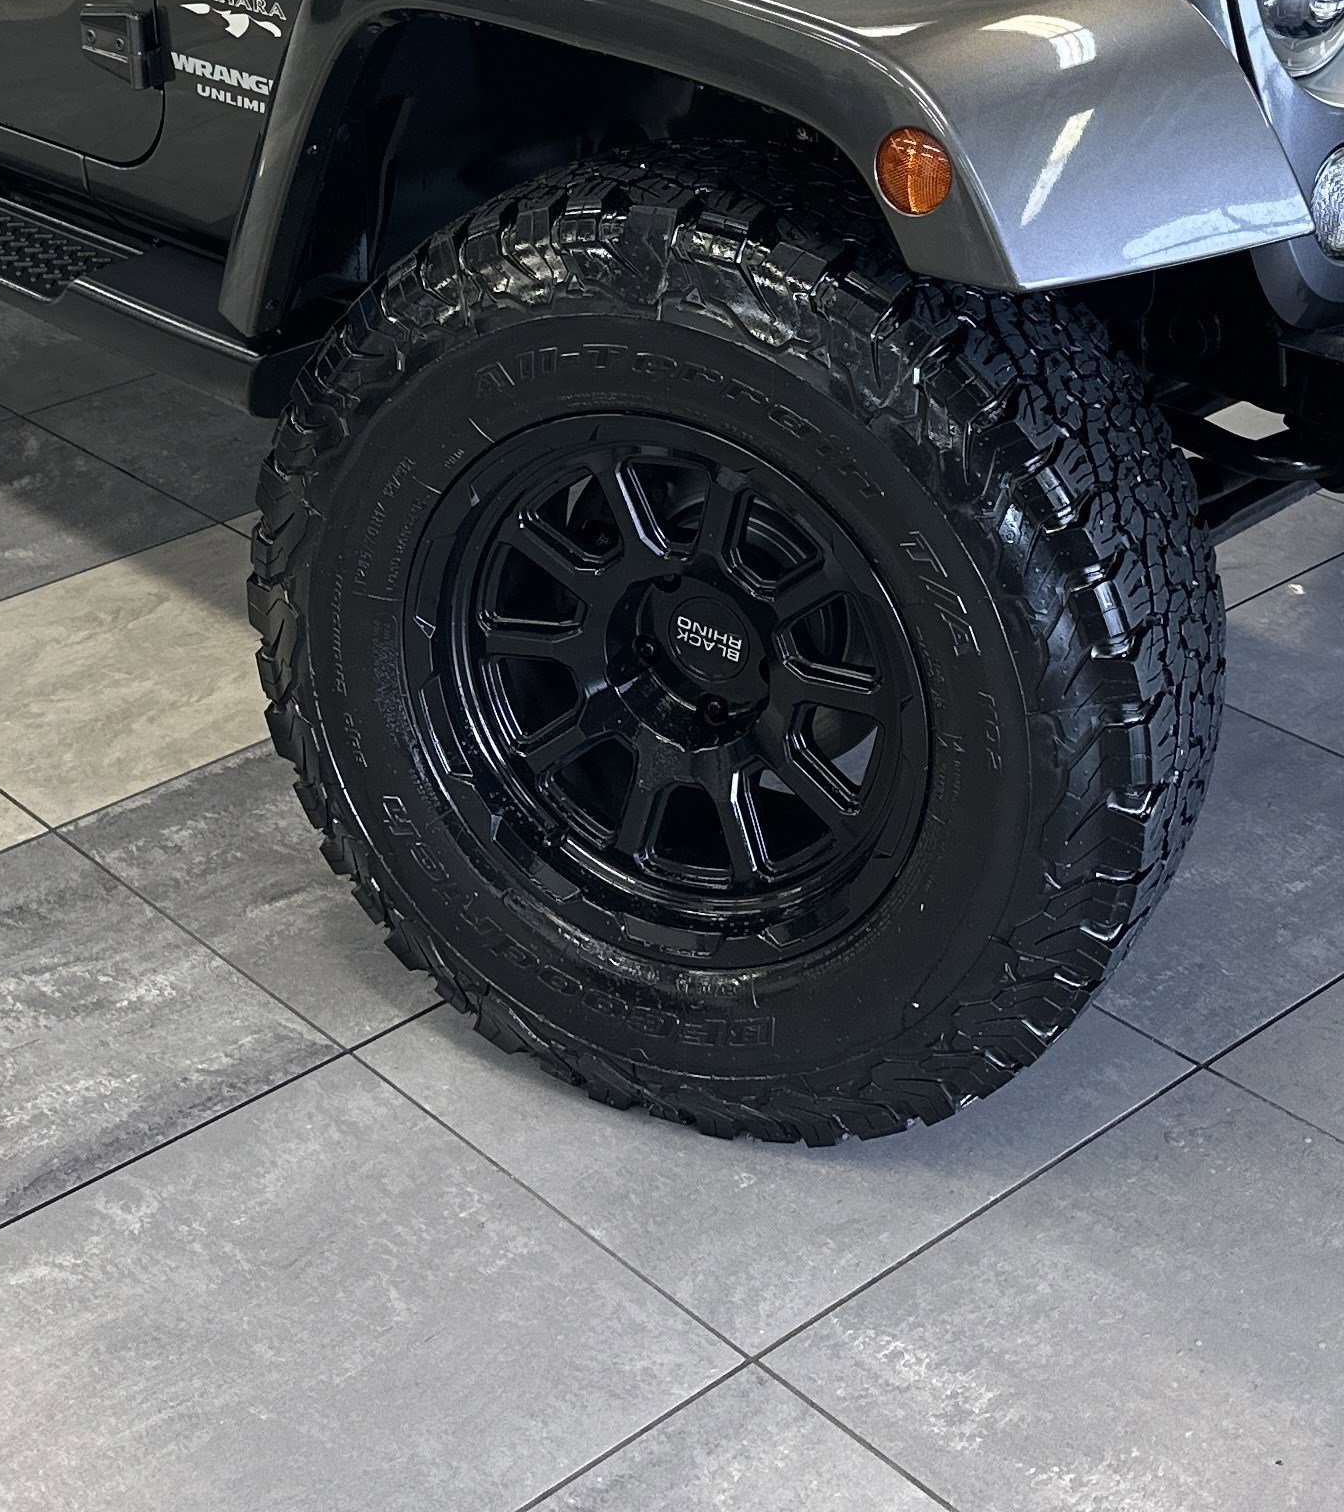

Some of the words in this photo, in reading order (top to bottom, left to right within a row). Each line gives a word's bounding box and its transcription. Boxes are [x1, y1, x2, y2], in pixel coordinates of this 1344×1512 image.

[197, 83, 266, 114] UNLIMI
[676, 615, 743, 650] RHINO
[676, 627, 741, 662] BLACK
